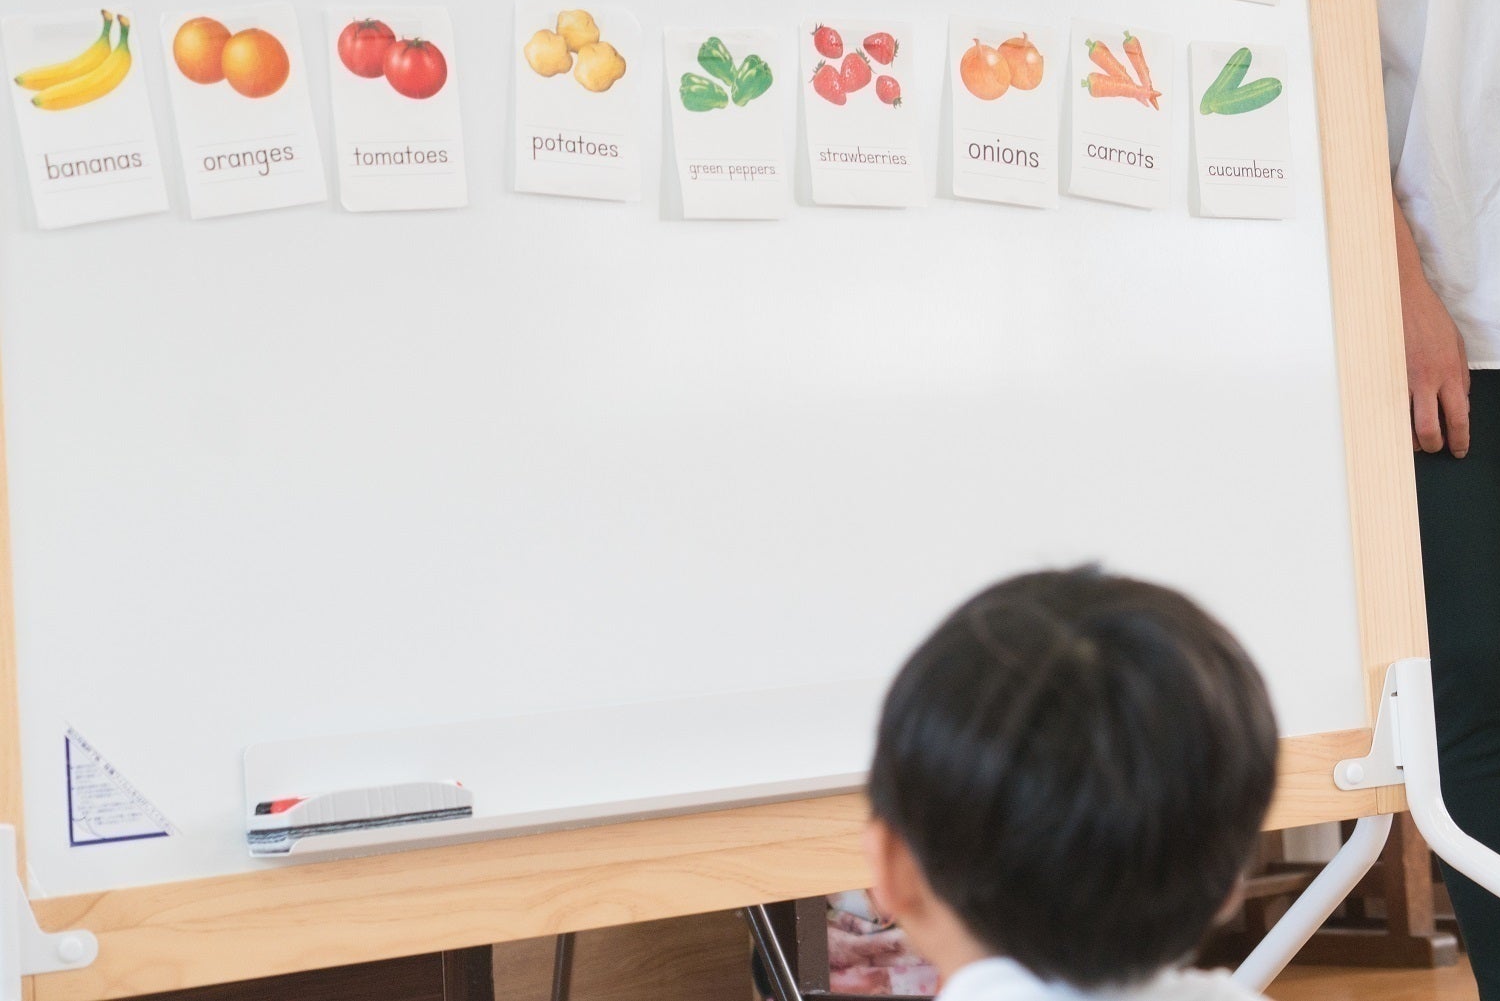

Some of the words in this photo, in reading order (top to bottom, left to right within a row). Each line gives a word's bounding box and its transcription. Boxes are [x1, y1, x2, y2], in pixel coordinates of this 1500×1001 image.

[353, 145, 448, 166] tomatoes
[532, 133, 619, 161] potatoes
[819, 146, 907, 165] strawberries
[968, 142, 1040, 169] onions
[1087, 143, 1154, 169] carrots
[44, 152, 143, 180] bananas
[203, 145, 294, 177] oranges
[689, 161, 724, 180] green
[728, 161, 776, 181] peppers
[1208, 159, 1284, 180] cucumbers
